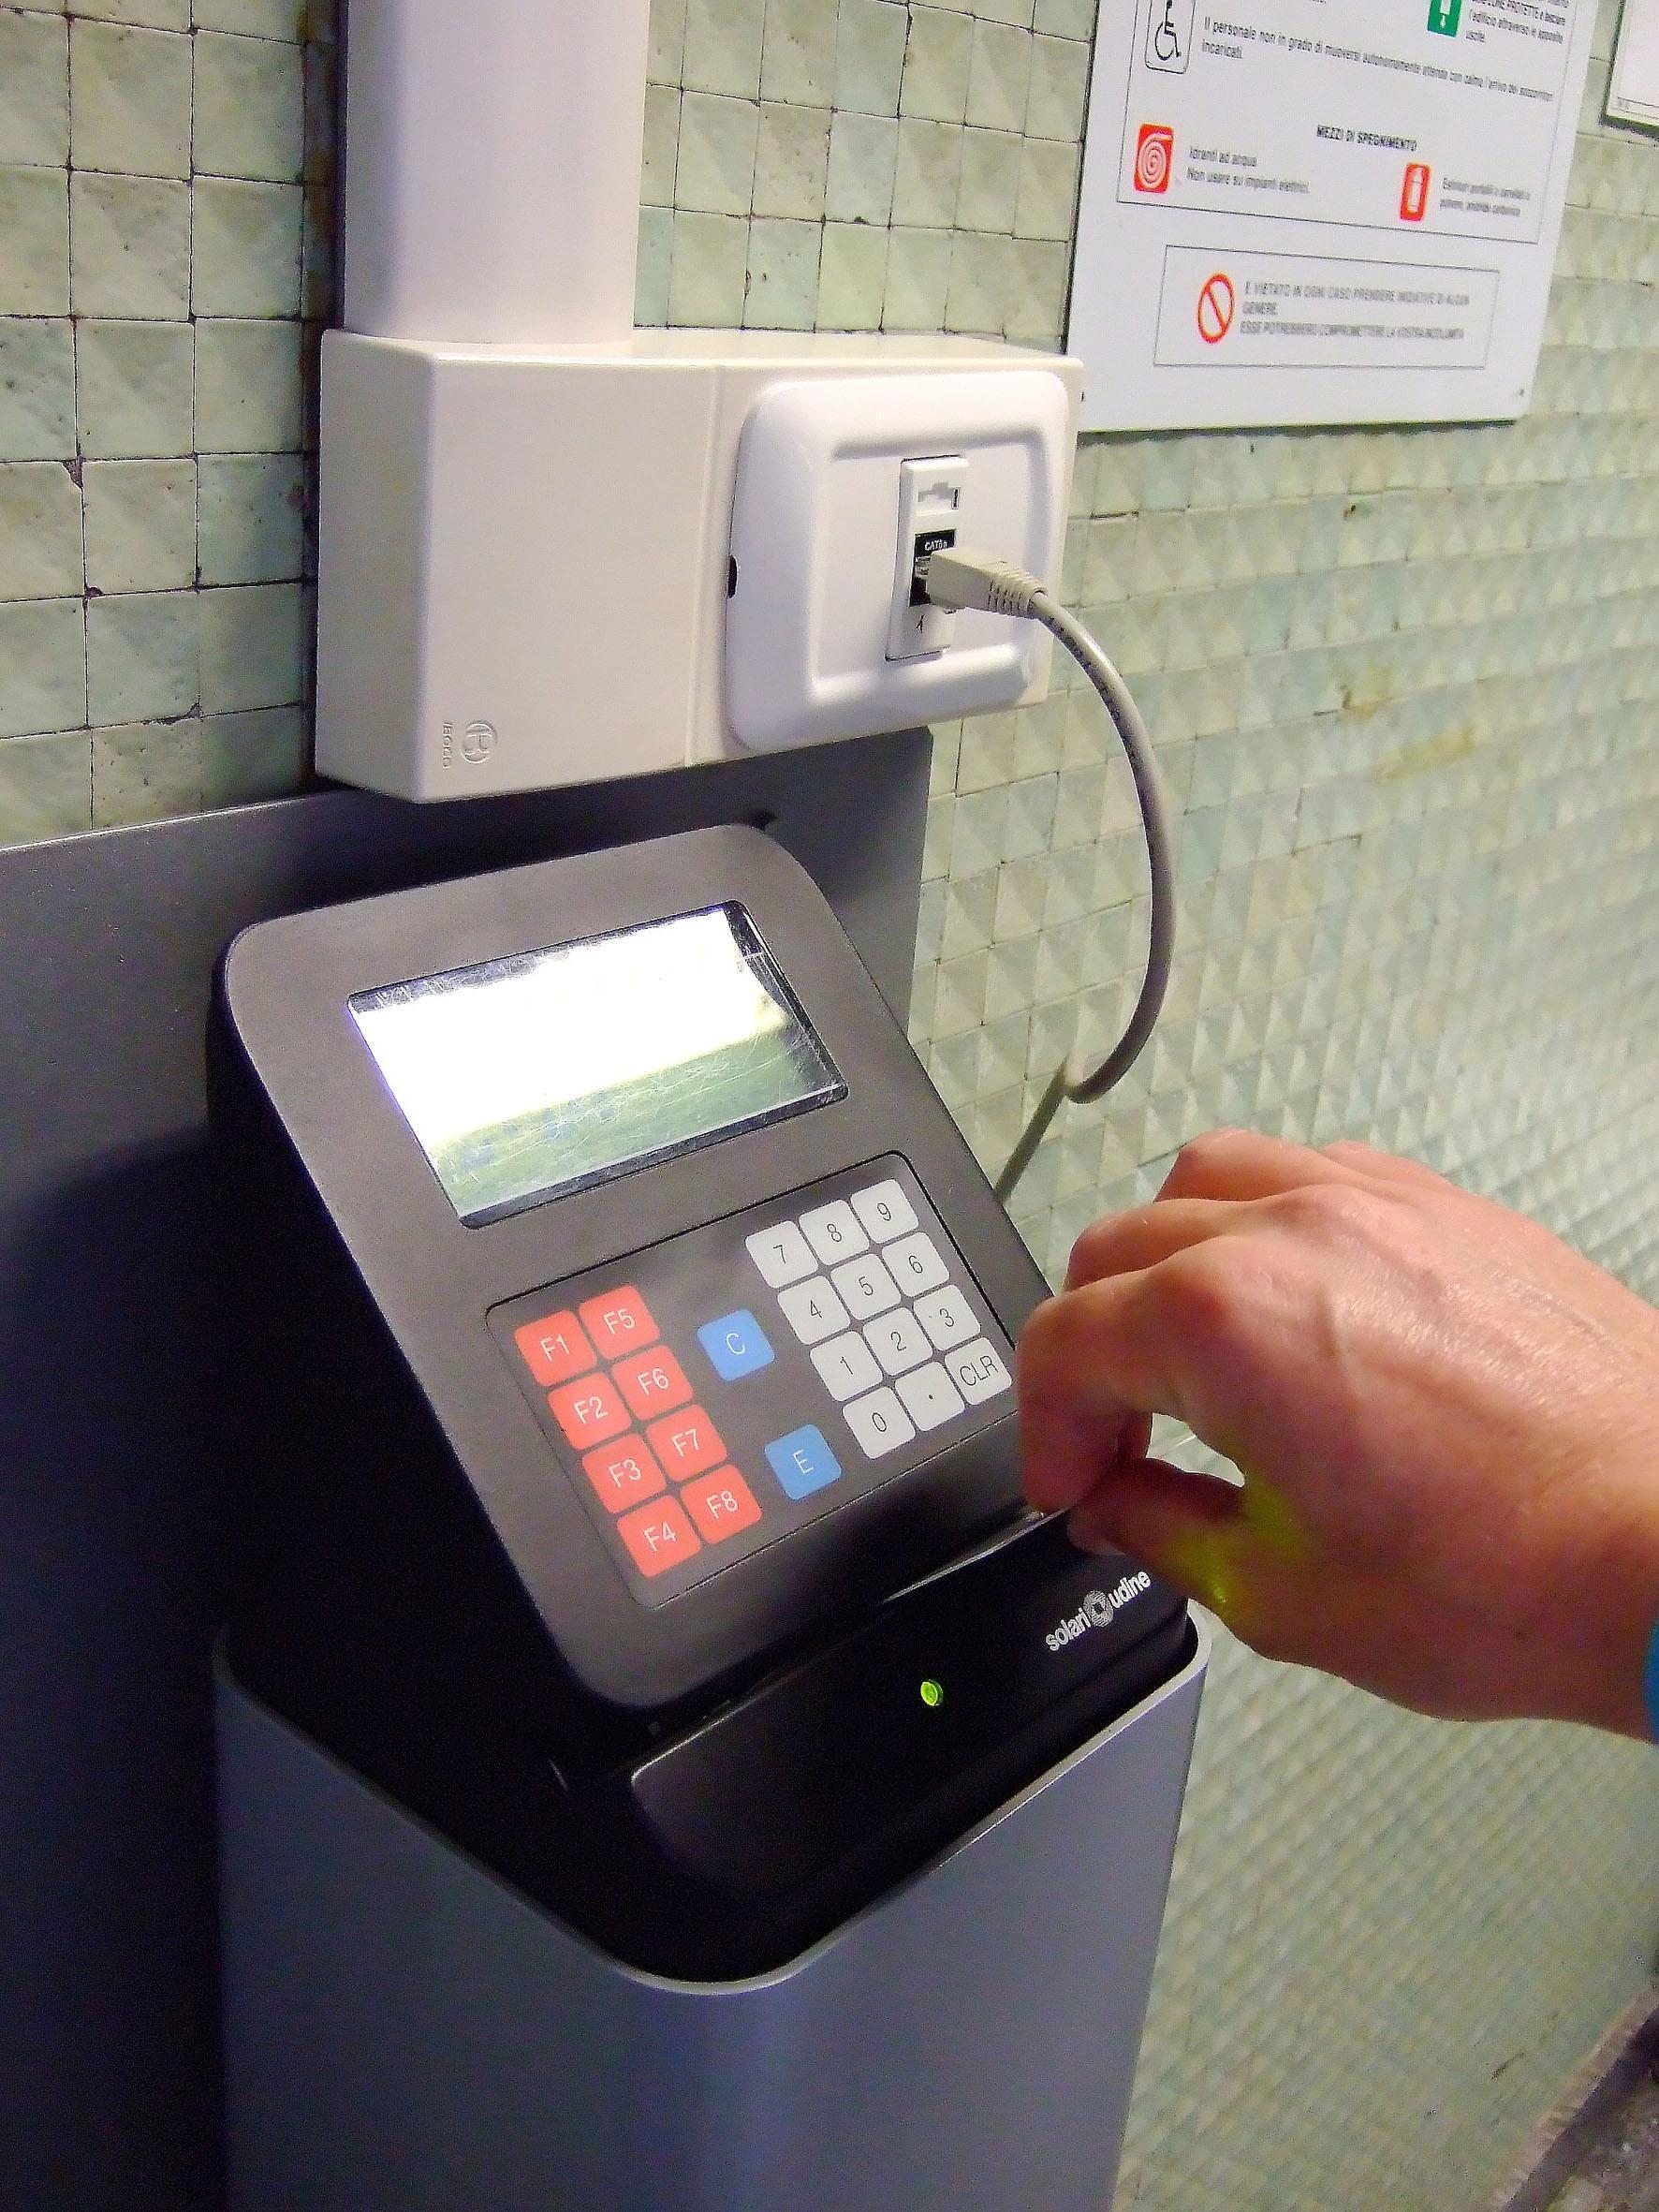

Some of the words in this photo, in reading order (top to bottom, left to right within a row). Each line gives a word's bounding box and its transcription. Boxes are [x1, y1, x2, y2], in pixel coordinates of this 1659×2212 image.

[1212, 21, 1256, 40] personale
[1259, 30, 1276, 44] non
[1278, 32, 1286, 46] in
[1288, 37, 1313, 52] grado
[1314, 39, 1323, 52] di
[1316, 124, 1343, 140] MEZZI
[1345, 129, 1355, 142] DI
[1357, 131, 1417, 152] SPEGNIMENTO
[1186, 167, 1205, 181] Non
[876, 1202, 892, 1222] 9
[827, 1223, 843, 1243] 8
[772, 1245, 786, 1264] 7
[908, 1255, 923, 1275] 6
[859, 1276, 874, 1296] 5
[603, 1307, 636, 1335] F5
[809, 1300, 823, 1320] 4
[939, 1308, 955, 1327] 3
[540, 1335, 571, 1362] F1
[726, 1333, 746, 1355] C
[890, 1331, 906, 1351] 2
[840, 1356, 854, 1376] 1
[960, 1354, 999, 1387] CLR
[637, 1368, 669, 1395] F6
[574, 1396, 609, 1424] F2
[872, 1411, 888, 1433] 0
[671, 1428, 700, 1457] F7
[609, 1459, 642, 1487] F3
[793, 1450, 814, 1475] E
[706, 1490, 739, 1519] F8
[644, 1522, 677, 1551] F4
[1045, 1607, 1092, 1651] solari
[1108, 1571, 1151, 1609] udine
